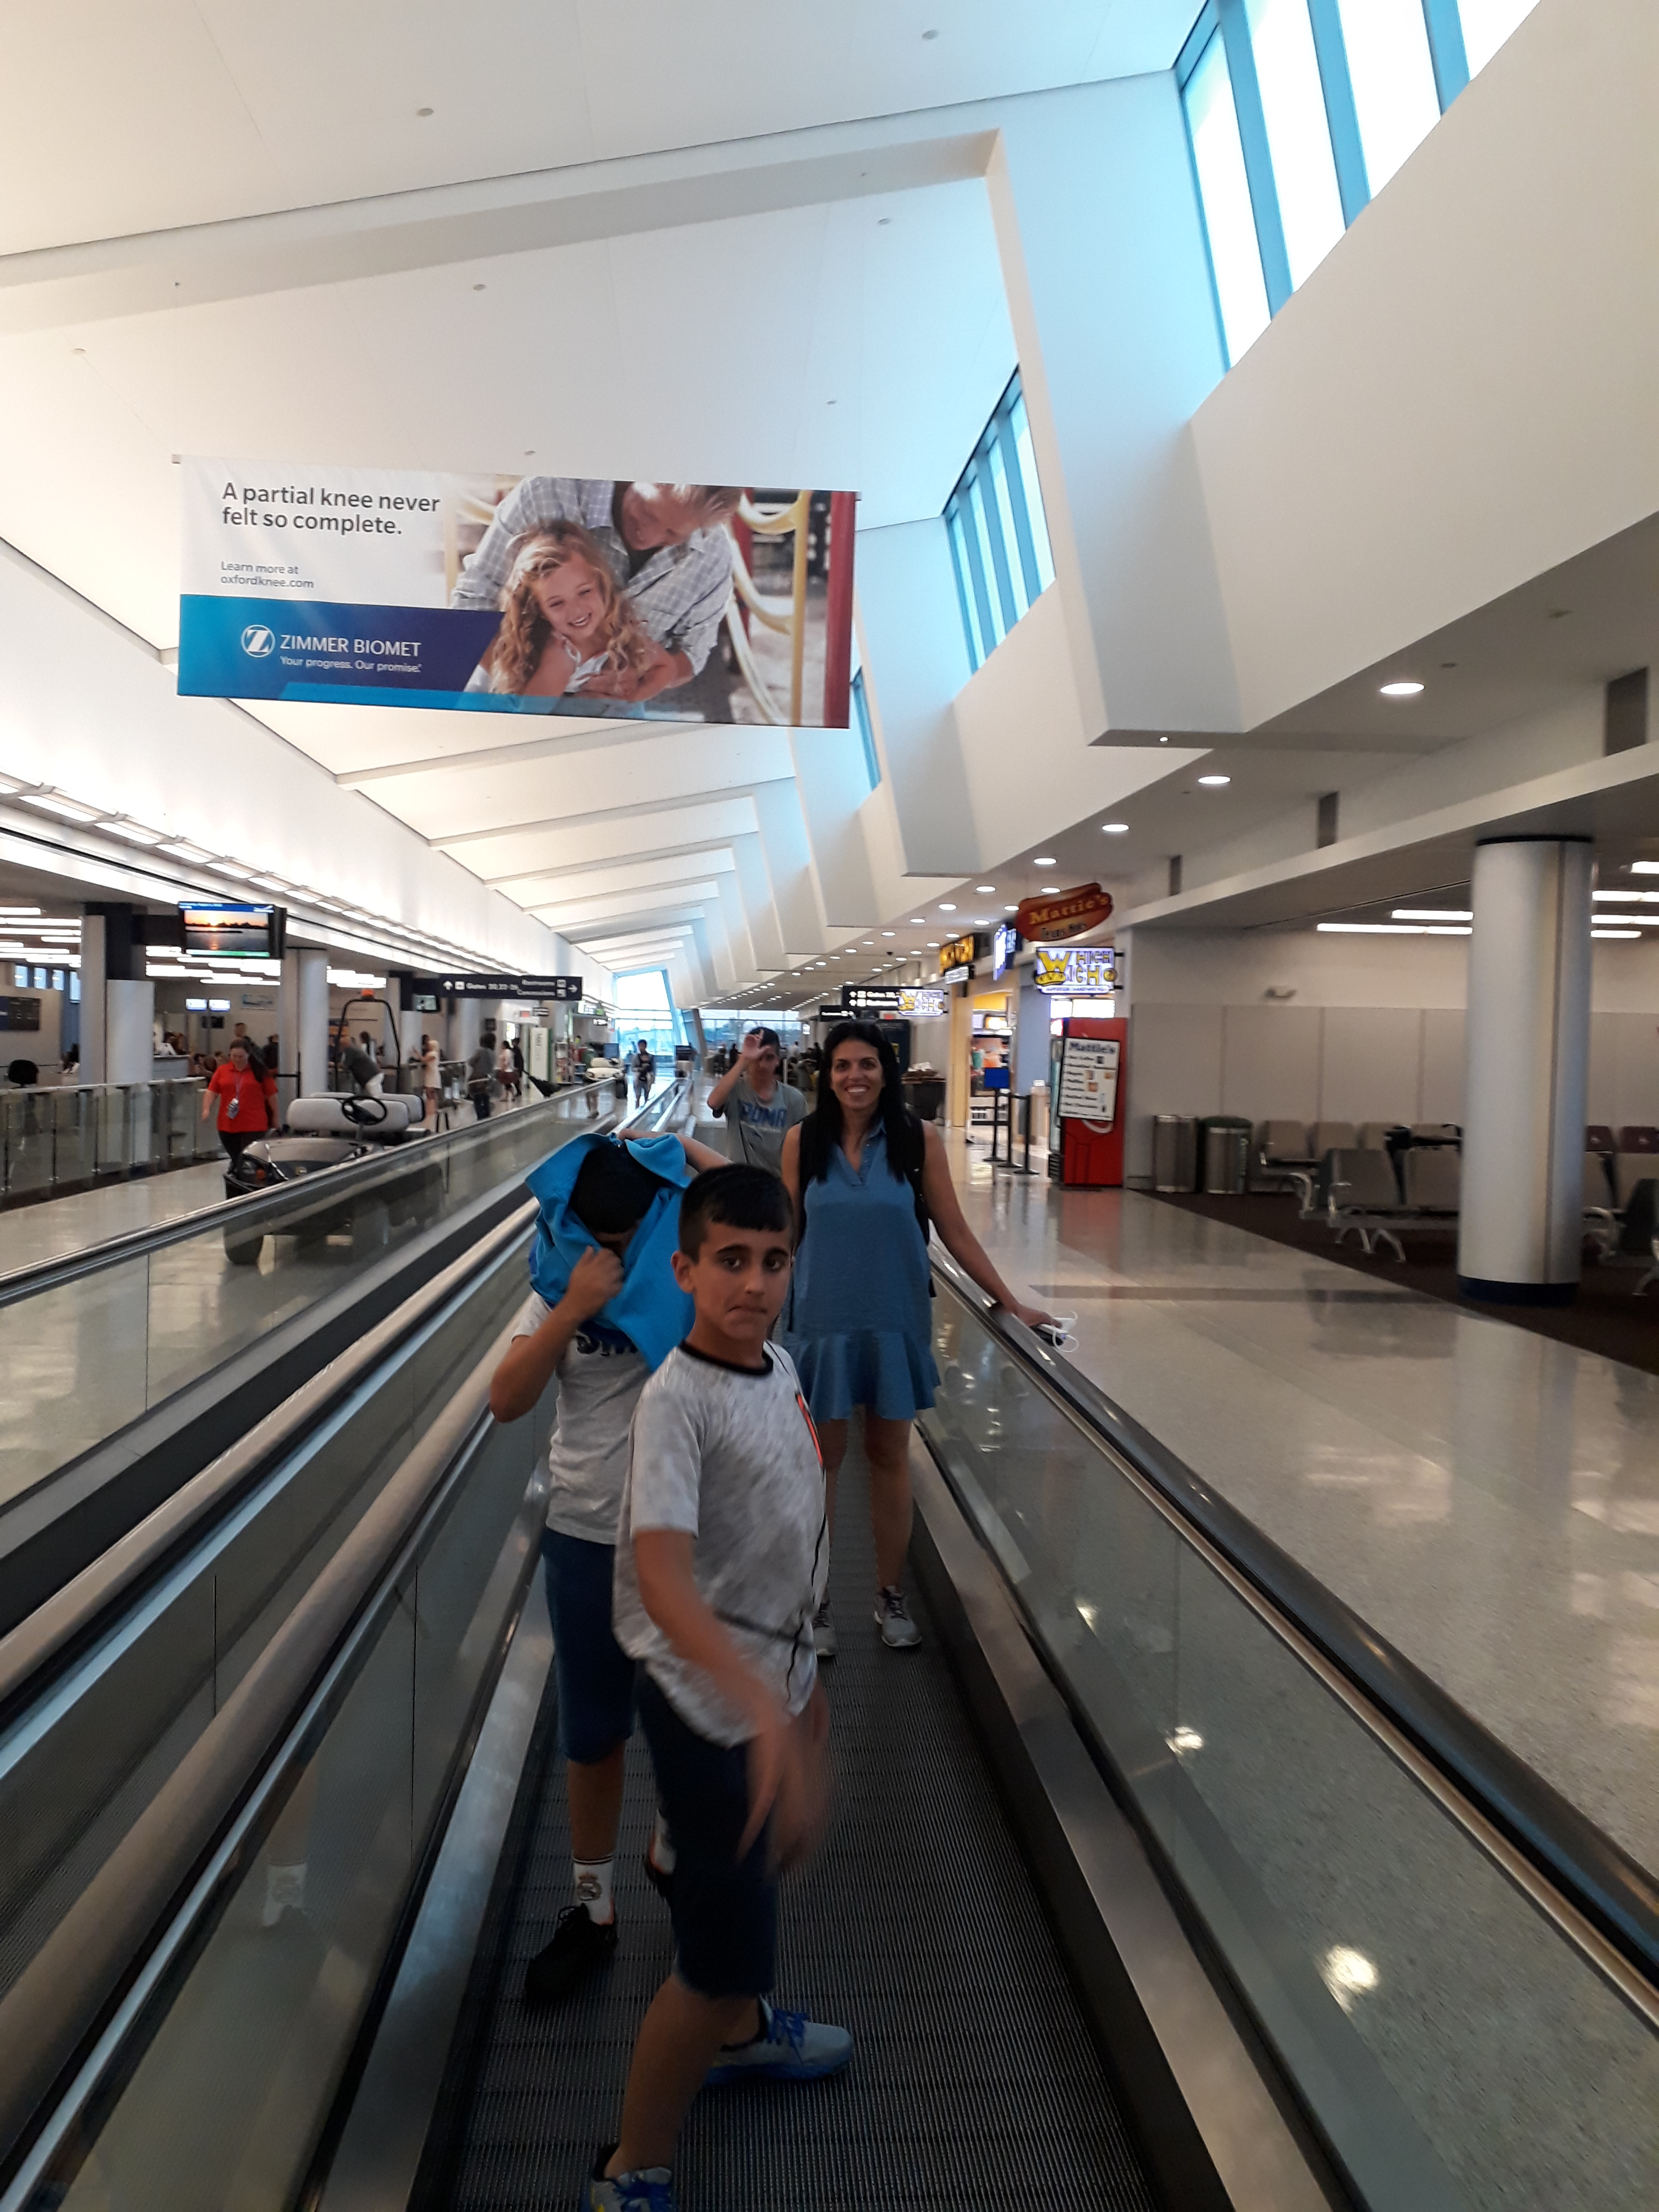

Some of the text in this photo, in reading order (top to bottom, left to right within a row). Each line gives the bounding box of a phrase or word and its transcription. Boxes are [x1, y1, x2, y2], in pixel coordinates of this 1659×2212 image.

[222, 482, 441, 512] A partial knee never
[222, 506, 402, 536] felt so complete.
[221, 561, 299, 574] Learn more at
[221, 574, 315, 588] oxfordknee.com
[280, 634, 422, 657] ZIMMER BIOMET
[279, 655, 303, 666] Your
[305, 659, 354, 669] progress.
[355, 659, 375, 670] Our
